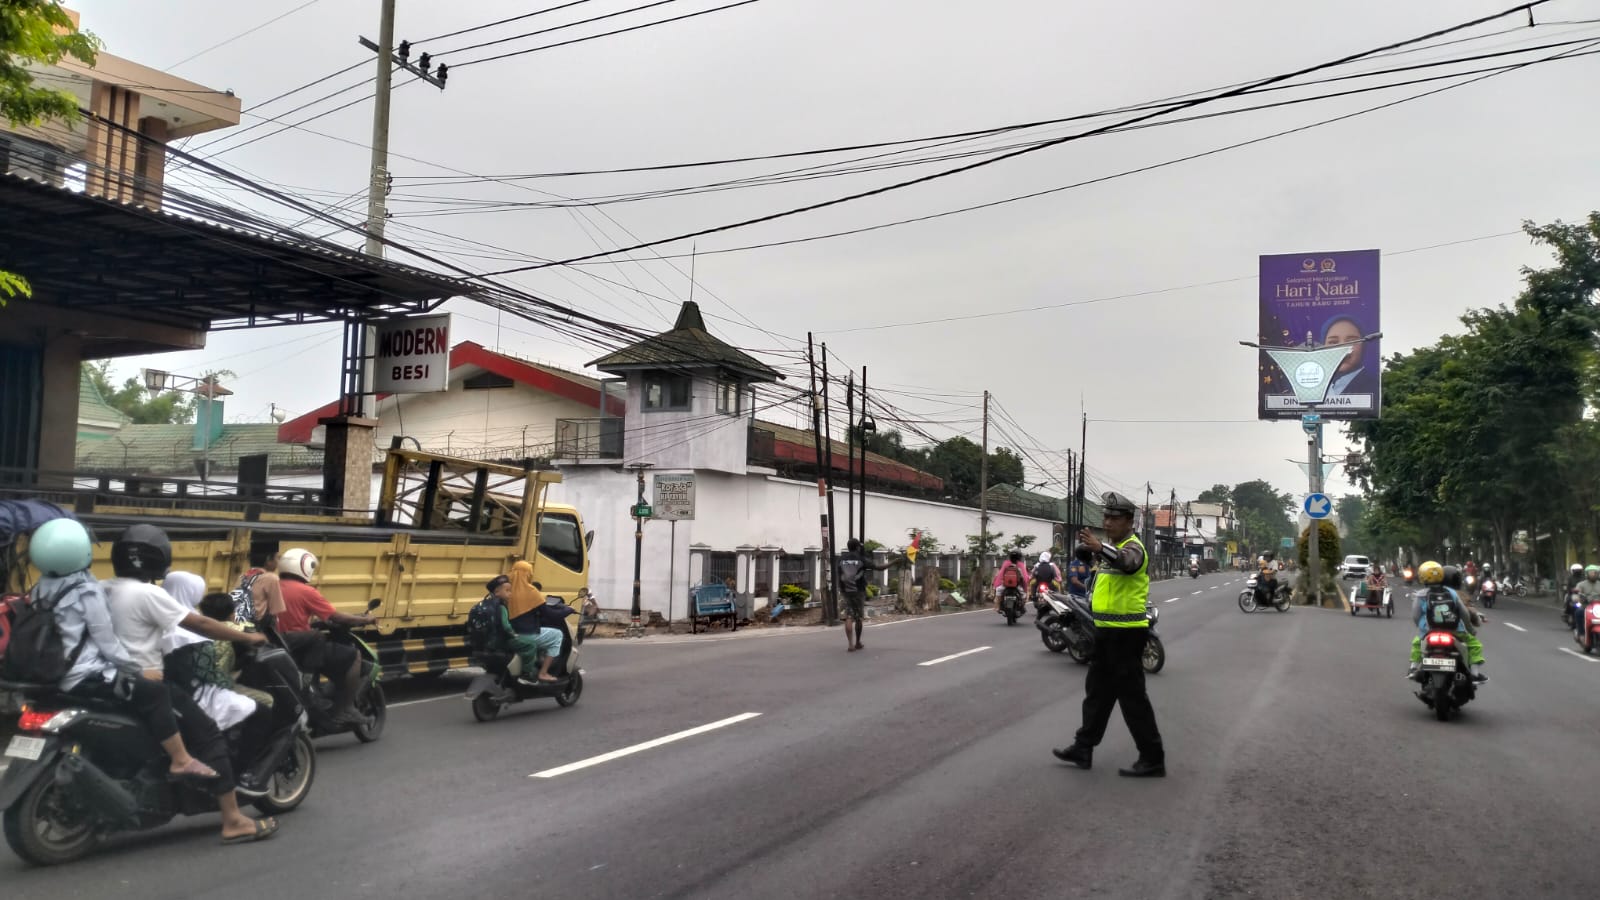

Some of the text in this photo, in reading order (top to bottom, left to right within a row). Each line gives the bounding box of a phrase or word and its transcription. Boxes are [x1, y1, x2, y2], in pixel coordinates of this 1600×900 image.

[1276, 280, 1359, 298] Hari Natal
[379, 326, 447, 358] MODERN
[391, 364, 429, 380] BESI
[1283, 398, 1299, 406] DIN
